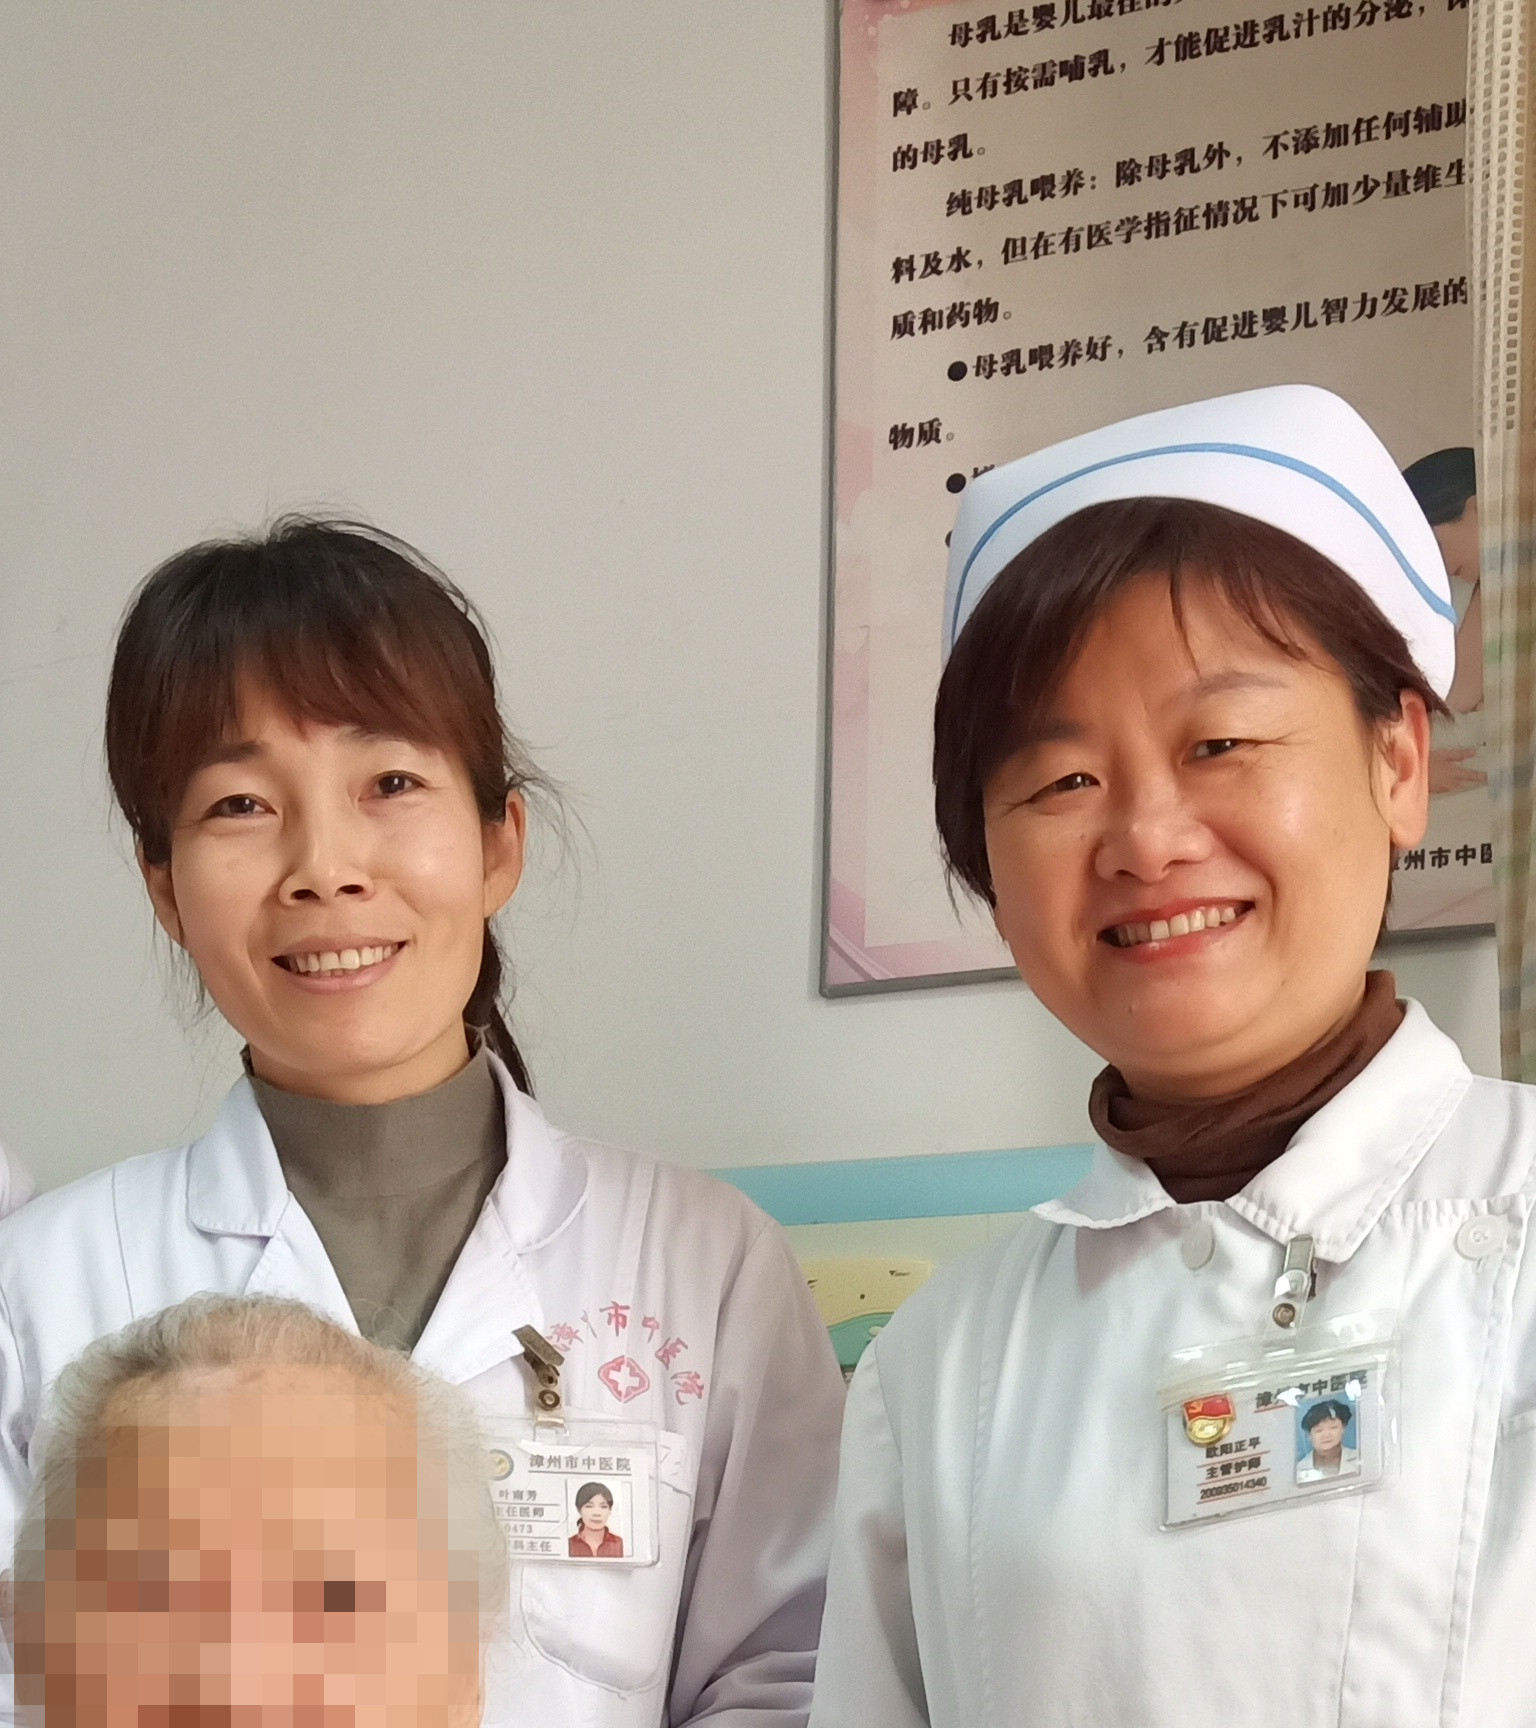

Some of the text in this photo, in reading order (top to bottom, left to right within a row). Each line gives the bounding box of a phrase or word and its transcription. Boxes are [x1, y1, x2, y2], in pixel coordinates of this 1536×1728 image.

[892, 133, 986, 172] 的母乳。
[890, 297, 1012, 341] 质和药物。
[888, 417, 955, 451] 物质。
[528, 1454, 632, 1473] 漳州市中医院
